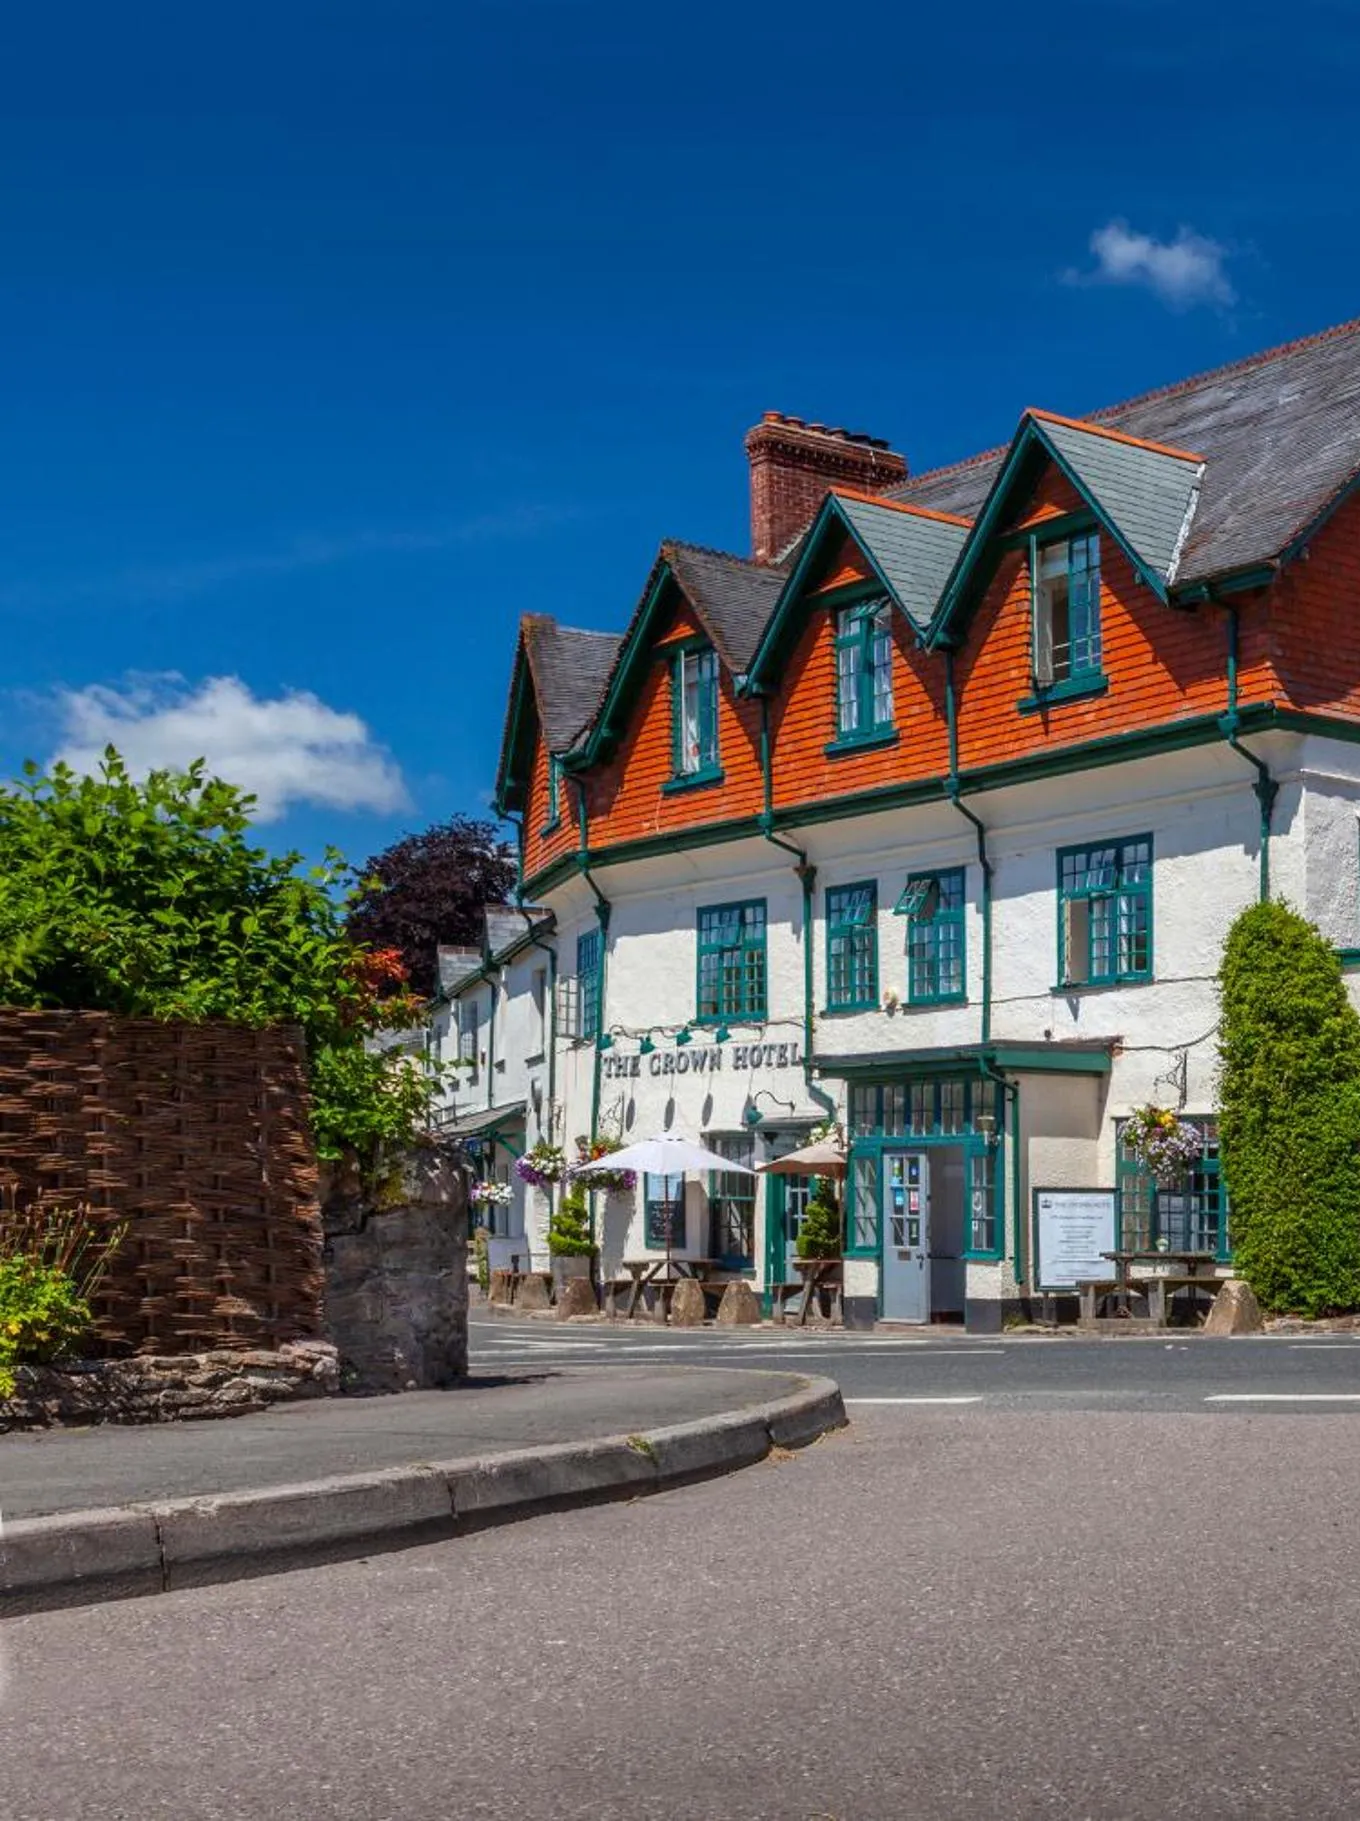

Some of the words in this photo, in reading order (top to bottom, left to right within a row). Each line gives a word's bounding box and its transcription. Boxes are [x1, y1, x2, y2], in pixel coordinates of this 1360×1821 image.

[602, 1054, 641, 1078] THE
[650, 1047, 723, 1077] CROWN
[731, 1042, 801, 1071] HOTEL
